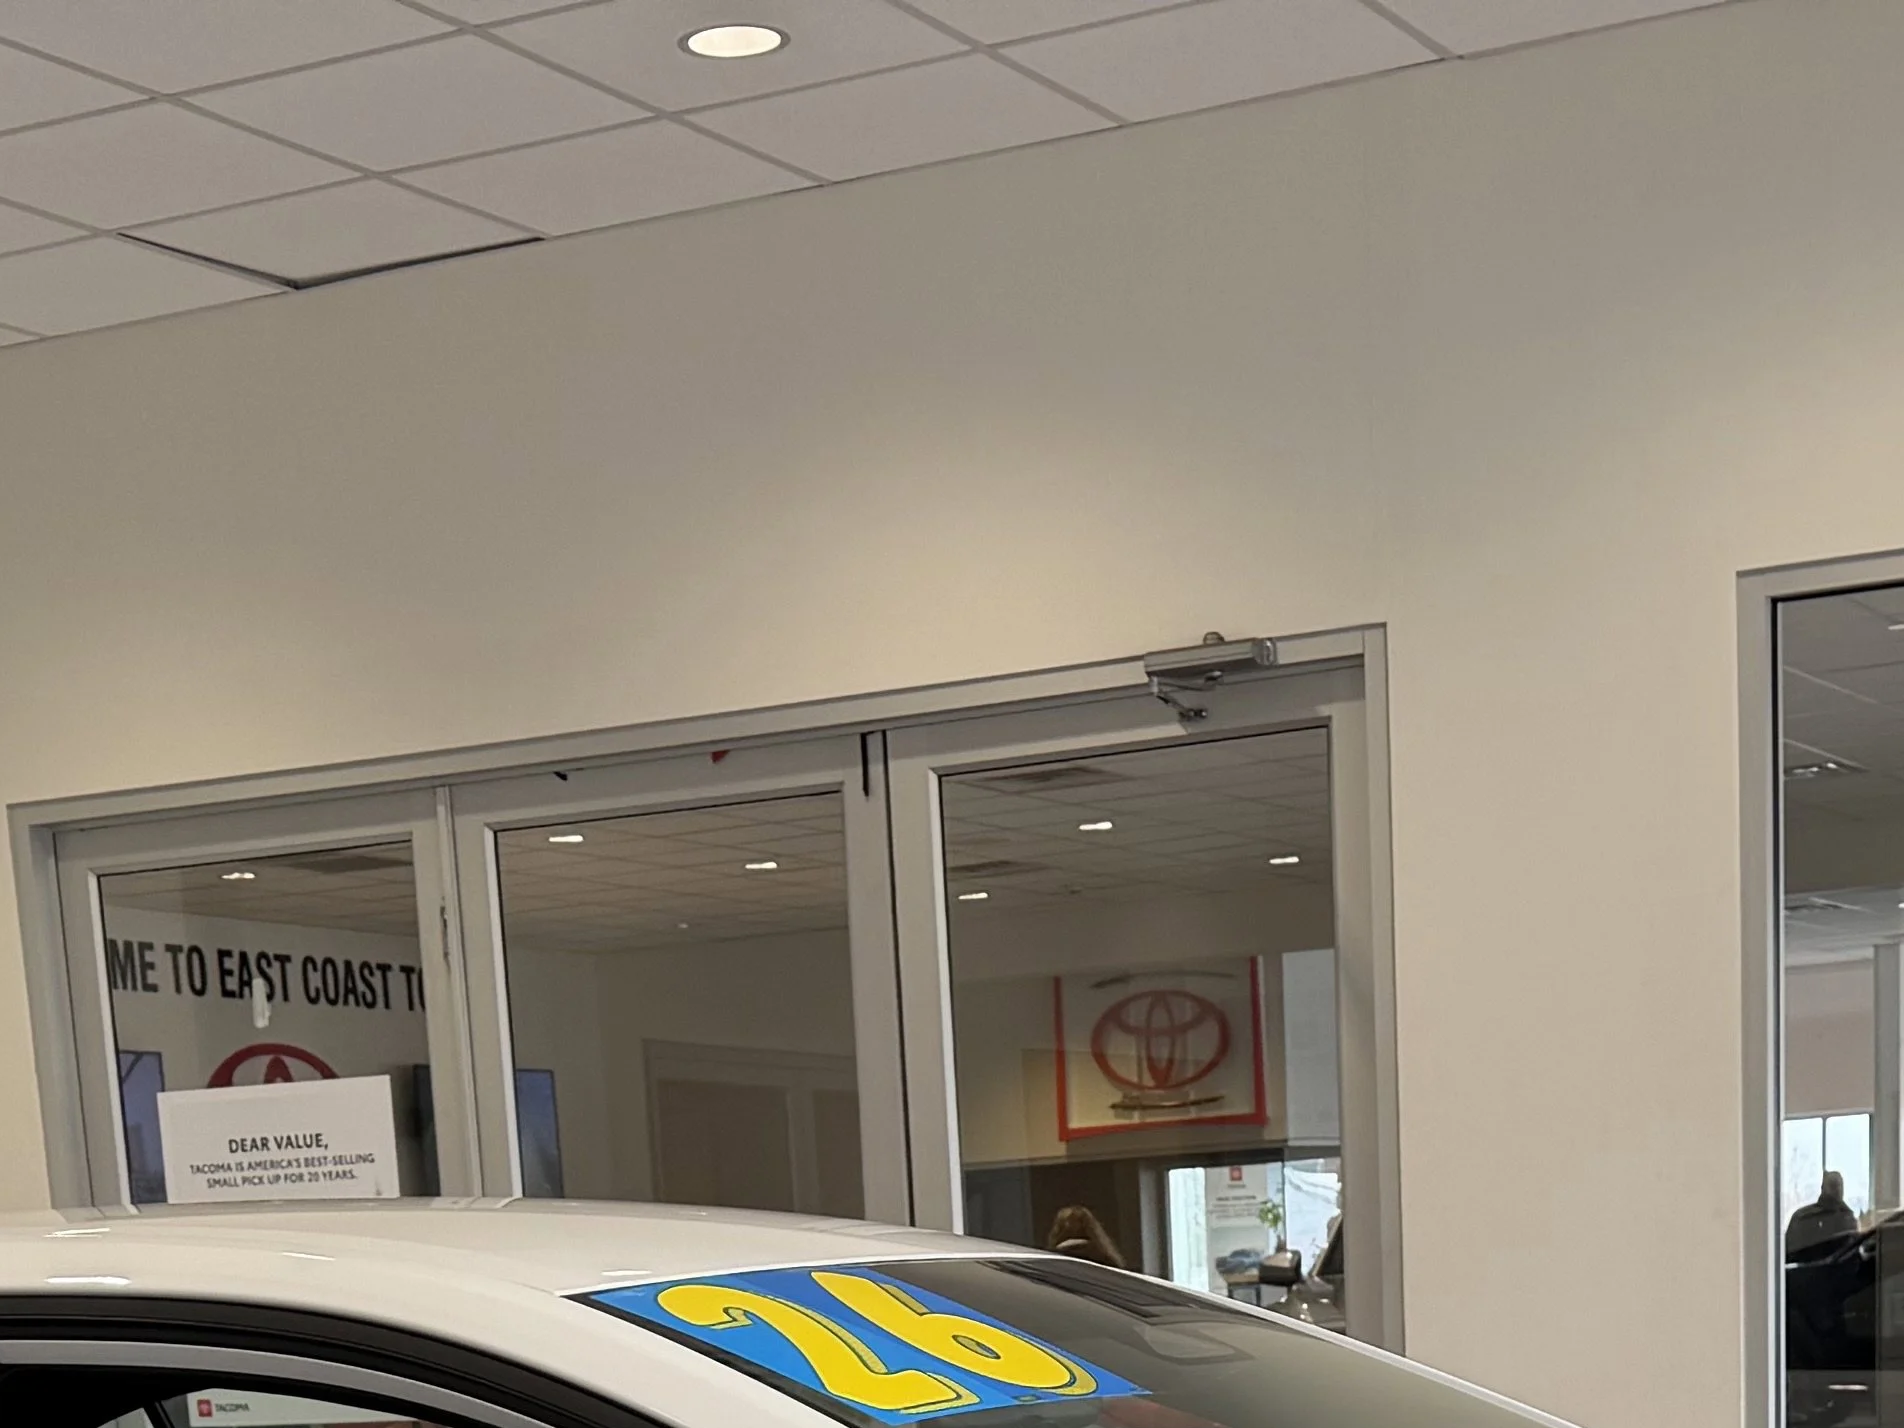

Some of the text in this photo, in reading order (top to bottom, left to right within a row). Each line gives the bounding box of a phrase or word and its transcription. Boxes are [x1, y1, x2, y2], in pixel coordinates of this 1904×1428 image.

[164, 943, 208, 997] TO
[217, 947, 293, 1003] EAST
[302, 954, 392, 1010] COAST
[227, 1132, 329, 1154] DEAR VALUE,
[189, 1152, 376, 1175] TACOMA IS AMERICA'S BEST-SELLING
[206, 1168, 358, 1189] SMALL PICK UP FOR 20 YEARS.
[658, 1270, 1098, 1413] 26
